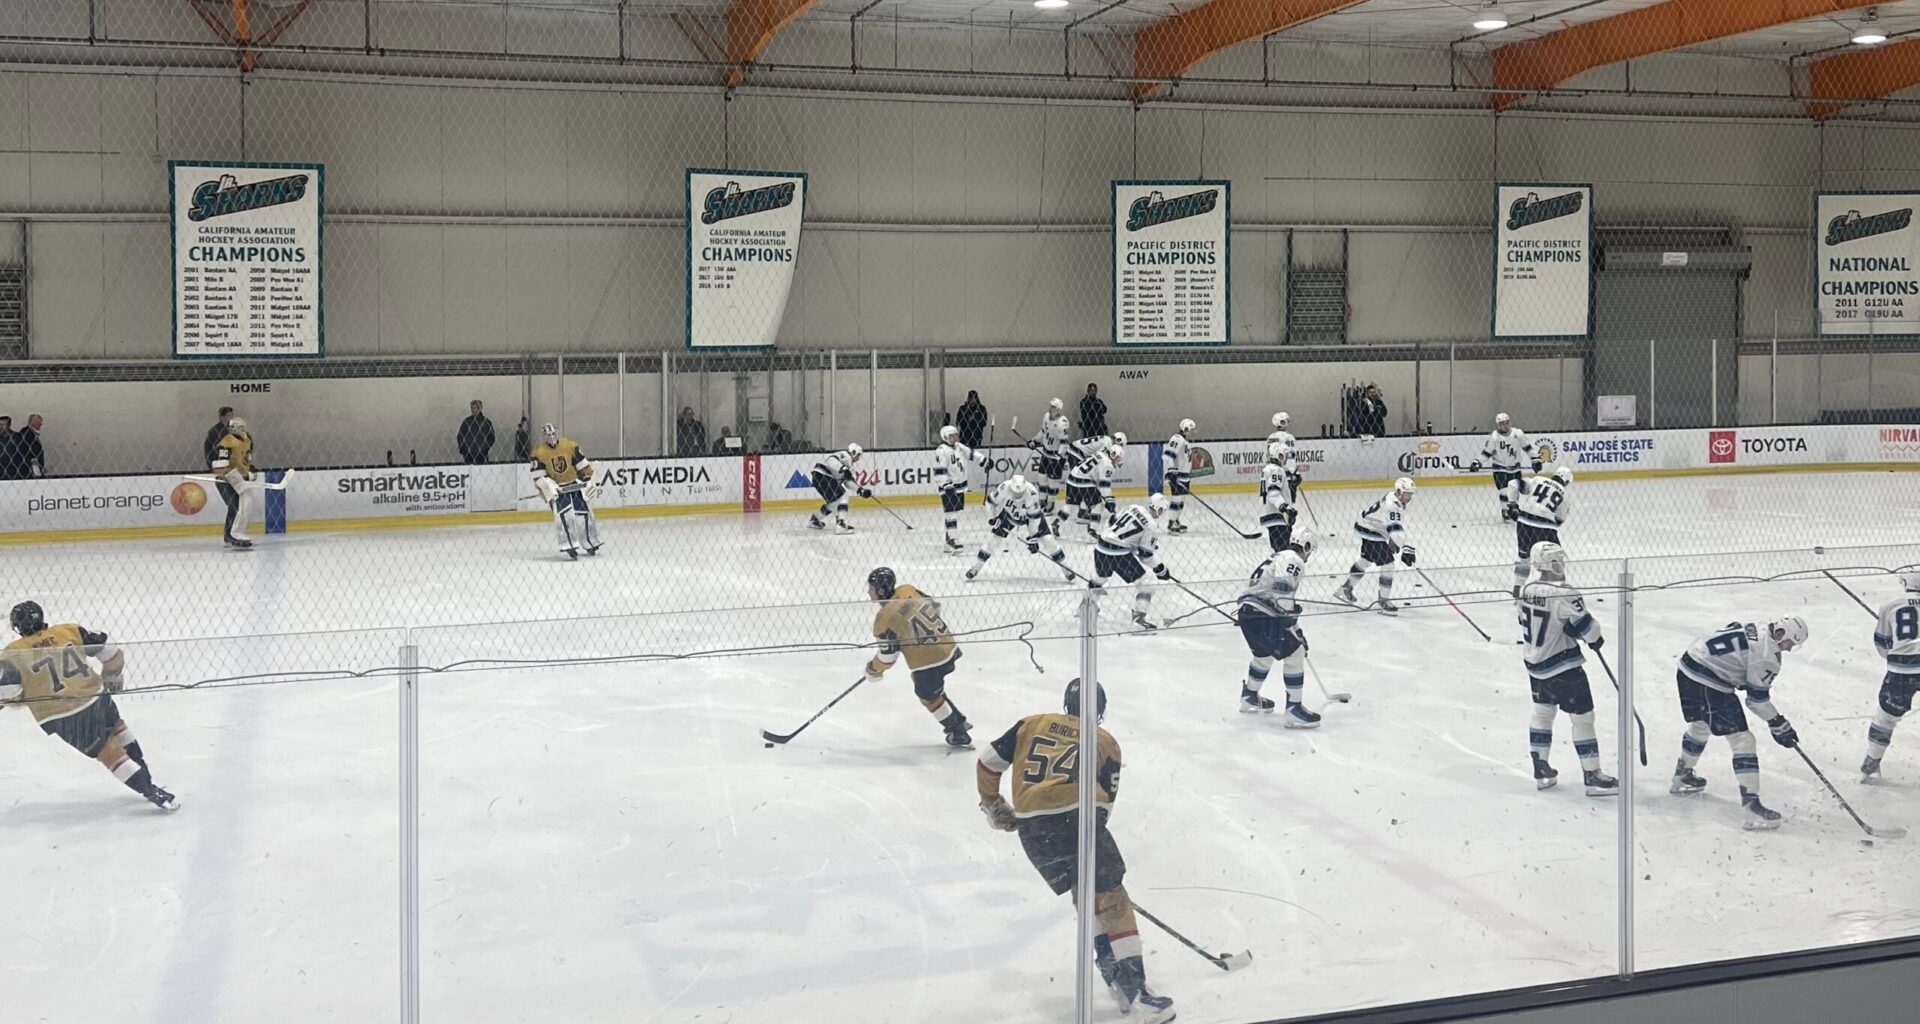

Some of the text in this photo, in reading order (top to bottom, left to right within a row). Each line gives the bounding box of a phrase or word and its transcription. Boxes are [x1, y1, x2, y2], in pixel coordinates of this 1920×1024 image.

[188, 174, 308, 221] SHARKS
[701, 182, 795, 224] SHARKS
[198, 226, 296, 236] CALIFORNIA AMATEUR
[198, 236, 296, 244] HOCKEY ASSOCIATION
[1127, 240, 1216, 250] PACIFIC DISTRICT
[1507, 240, 1581, 248] PACIFIC DISTRICT
[189, 246, 306, 262] CHAMPIONS
[702, 247, 792, 262] CHAMPIONS
[1127, 252, 1216, 265] CHAMPIONS
[1507, 250, 1581, 262] CHAMPIONS
[1830, 258, 1911, 271] NATIONAL
[1821, 281, 1919, 295] CHAMPIONS
[1835, 298, 1904, 307] 2011 G12U AA
[1835, 310, 1858, 318] 2017
[1891, 310, 1904, 318] AA
[1119, 370, 1149, 380] AWAY
[230, 382, 271, 394] HOME
[1880, 428, 1920, 442] NIRVA
[1563, 441, 1587, 452] SAN
[1621, 439, 1654, 450] STATE
[1742, 437, 1807, 454] TOYOTA
[1222, 452, 1241, 465] NEW
[1242, 451, 1265, 464] YORK
[1295, 450, 1325, 462] AUSAGE
[1398, 451, 1461, 475] Corona
[1578, 451, 1639, 464] ATHLETICS
[337, 471, 470, 493] smartwater
[642, 465, 711, 485] MEDIA
[748, 459, 757, 500] CCM
[884, 467, 931, 485] LIGH
[1271, 474, 1283, 483] 94
[28, 493, 164, 515] planet orange
[372, 490, 466, 504] alkaline 9.5+pH
[1533, 484, 1564, 513] 49
[405, 503, 466, 512] with antioxidant
[1390, 511, 1401, 521] 83
[1112, 513, 1144, 540] 47
[910, 603, 948, 645] 45
[1521, 605, 1551, 648] 37
[31, 643, 90, 693] 74
[1023, 734, 1080, 785] 54
